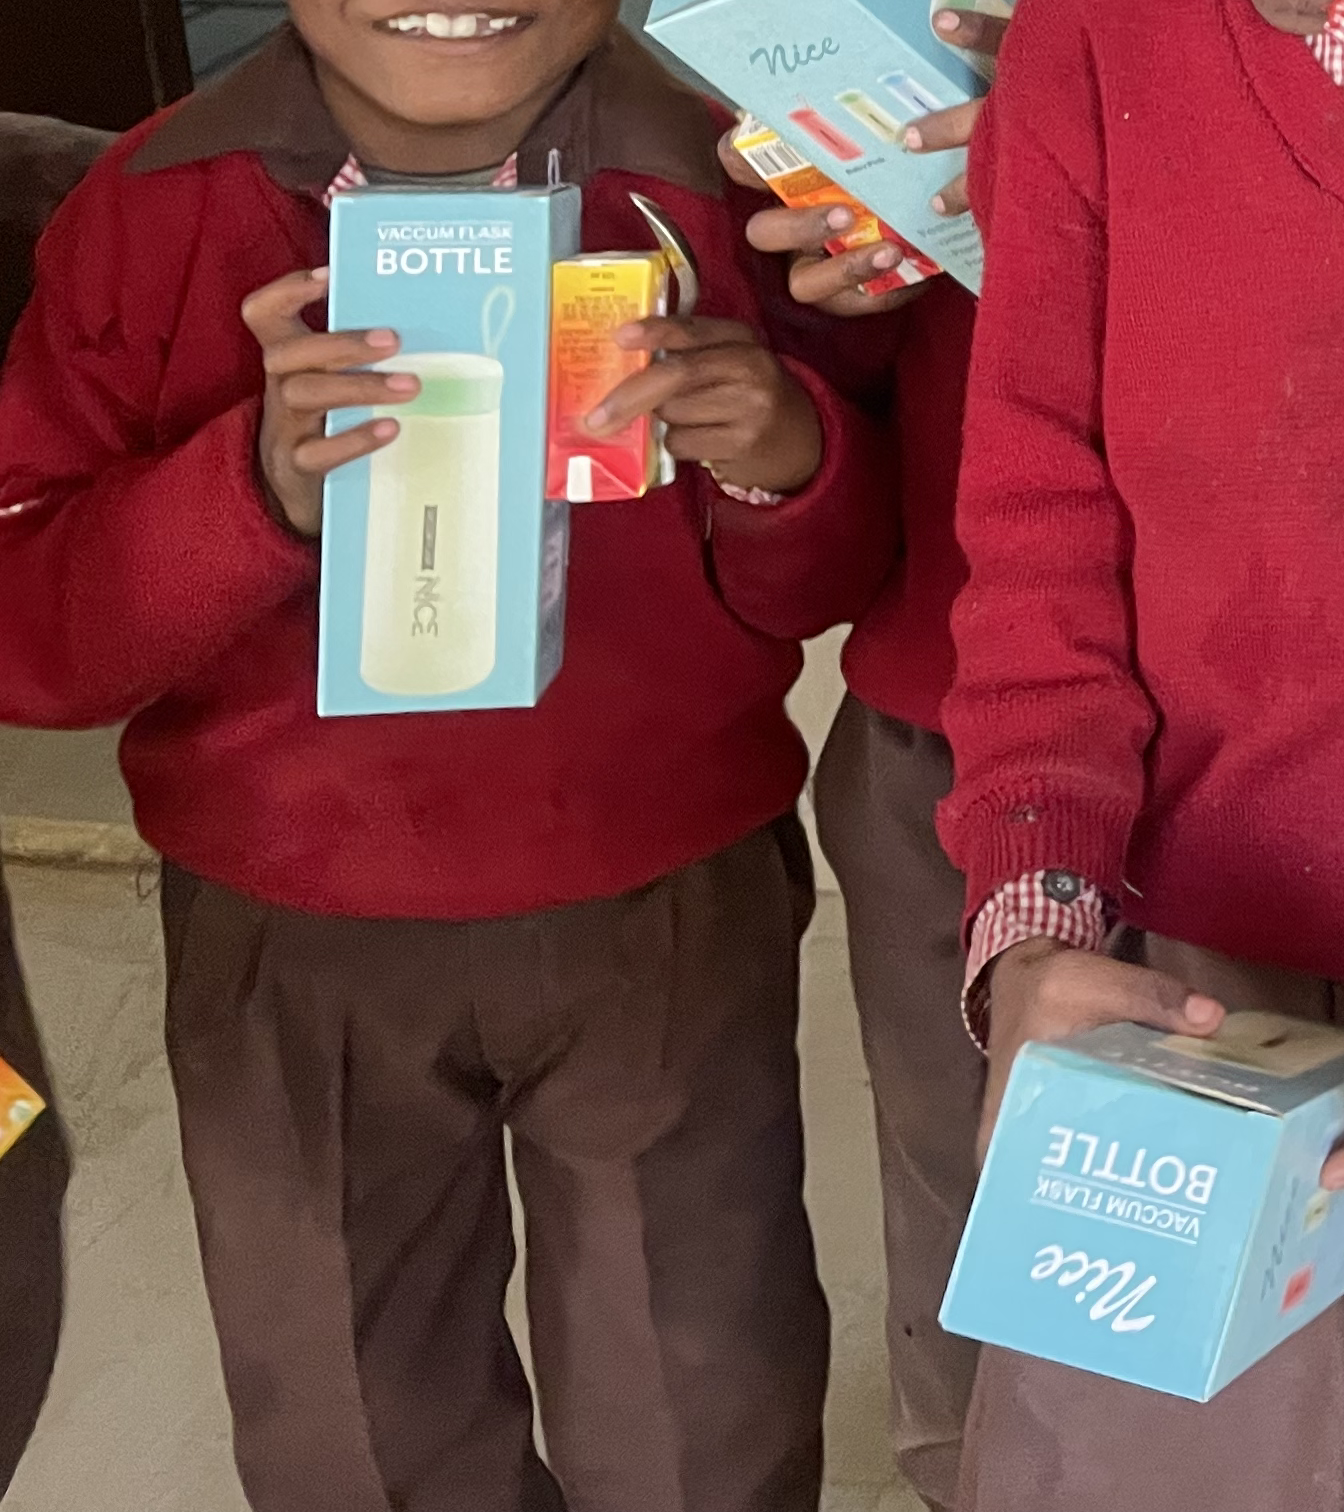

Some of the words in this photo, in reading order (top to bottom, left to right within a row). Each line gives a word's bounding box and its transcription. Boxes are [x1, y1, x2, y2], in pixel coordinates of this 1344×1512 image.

[750, 36, 841, 76] Nice
[377, 226, 455, 241] VACCUM
[376, 248, 513, 275] BOTTLE
[1041, 1125, 1218, 1205] BOTTLE
[1034, 1175, 1103, 1210] FLASK
[1106, 1195, 1199, 1238] VACCUM
[1030, 1244, 1157, 1332] Nice
